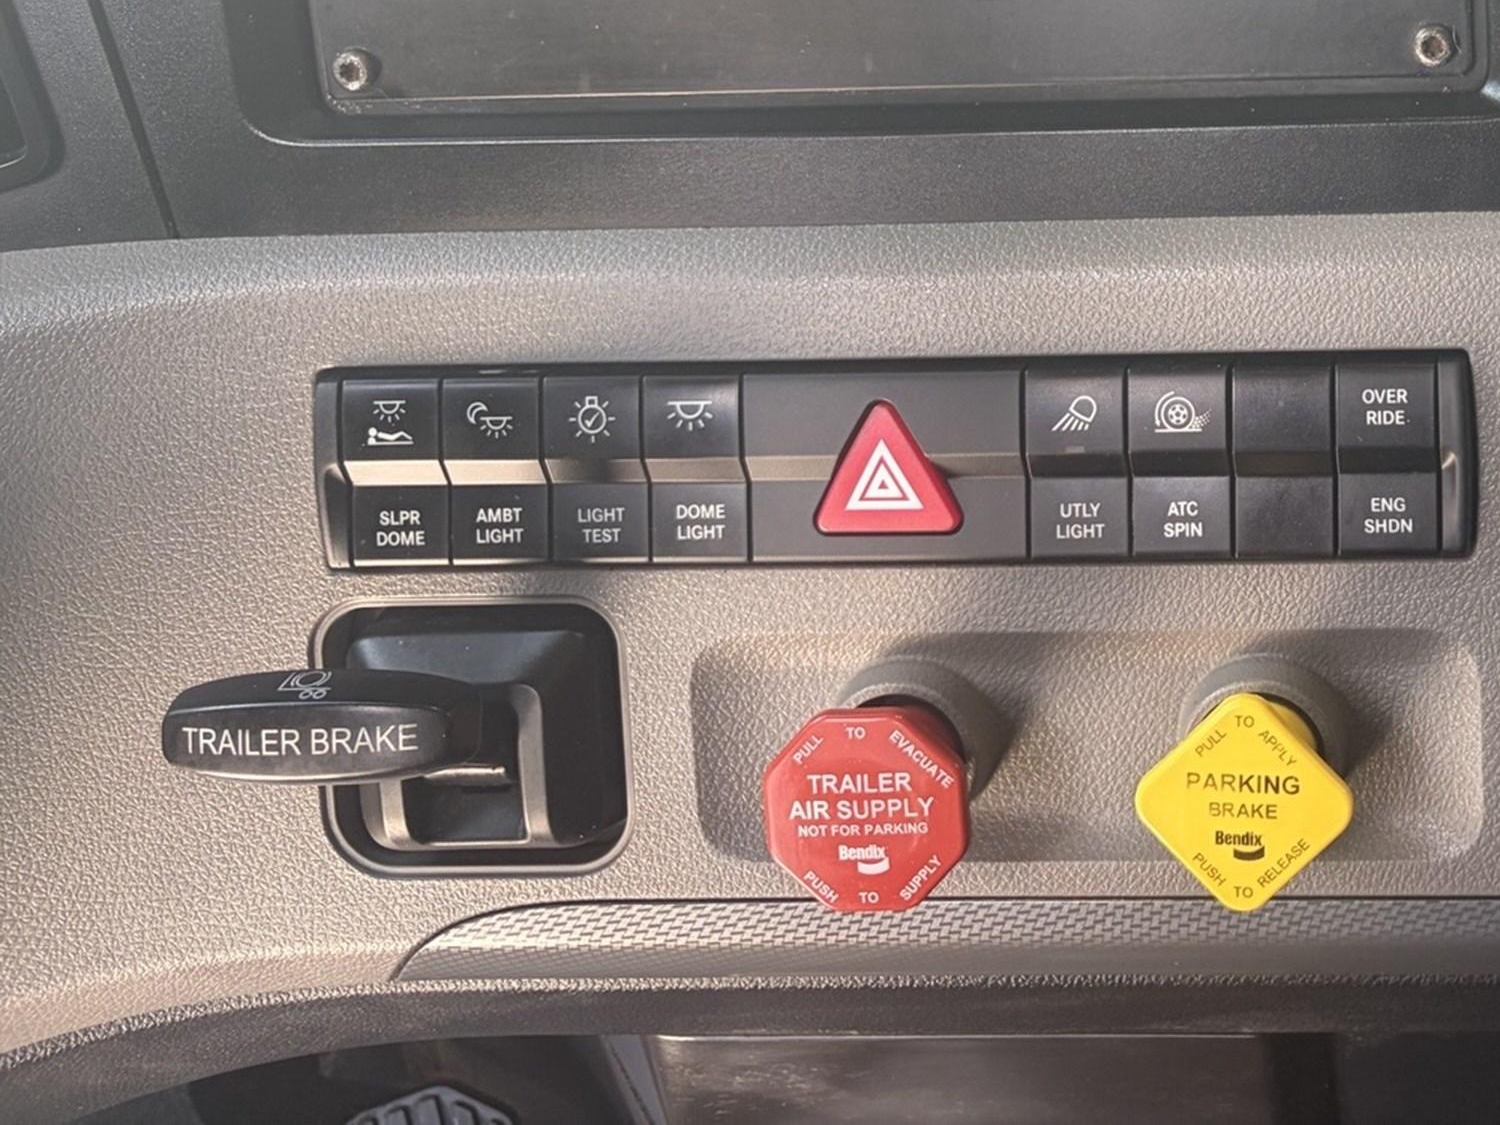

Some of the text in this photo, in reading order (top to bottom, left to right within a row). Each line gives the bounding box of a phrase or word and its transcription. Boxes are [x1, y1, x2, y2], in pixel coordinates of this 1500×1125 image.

[1362, 388, 1408, 405] OVER
[1365, 410, 1406, 426] RIDE
[675, 504, 726, 520] DOME
[1059, 502, 1101, 518] UTLY
[1167, 501, 1199, 517] ATC
[1370, 497, 1406, 513] ENG
[379, 510, 421, 527] SLPR
[475, 507, 523, 524] AMBT
[577, 507, 625, 523] LIGHT
[676, 524, 725, 540] LIGHT
[1056, 523, 1105, 539] LIGHT
[1163, 521, 1203, 538] SPIN
[1363, 518, 1414, 534] SHDN
[376, 530, 425, 547] DOME
[475, 528, 524, 544] LIGHT
[582, 528, 622, 543] TEST
[182, 723, 419, 756] TRAILER BRAKE
[1194, 715, 1298, 767] PULL TO APPLY
[793, 726, 955, 789] PULL TO EVACUATE
[806, 772, 912, 795] TRAILER
[1186, 772, 1300, 795] PARKING
[789, 797, 934, 820] AIR SUPPLY
[1208, 802, 1278, 819] BRAKE
[797, 822, 928, 838] NOT FOR PARKING
[1215, 830, 1262, 846] Bendix
[838, 844, 886, 861] Bendix
[1192, 838, 1310, 899] PUSH TO RELEASE
[803, 854, 942, 904] PUSH TO SUPPLY
